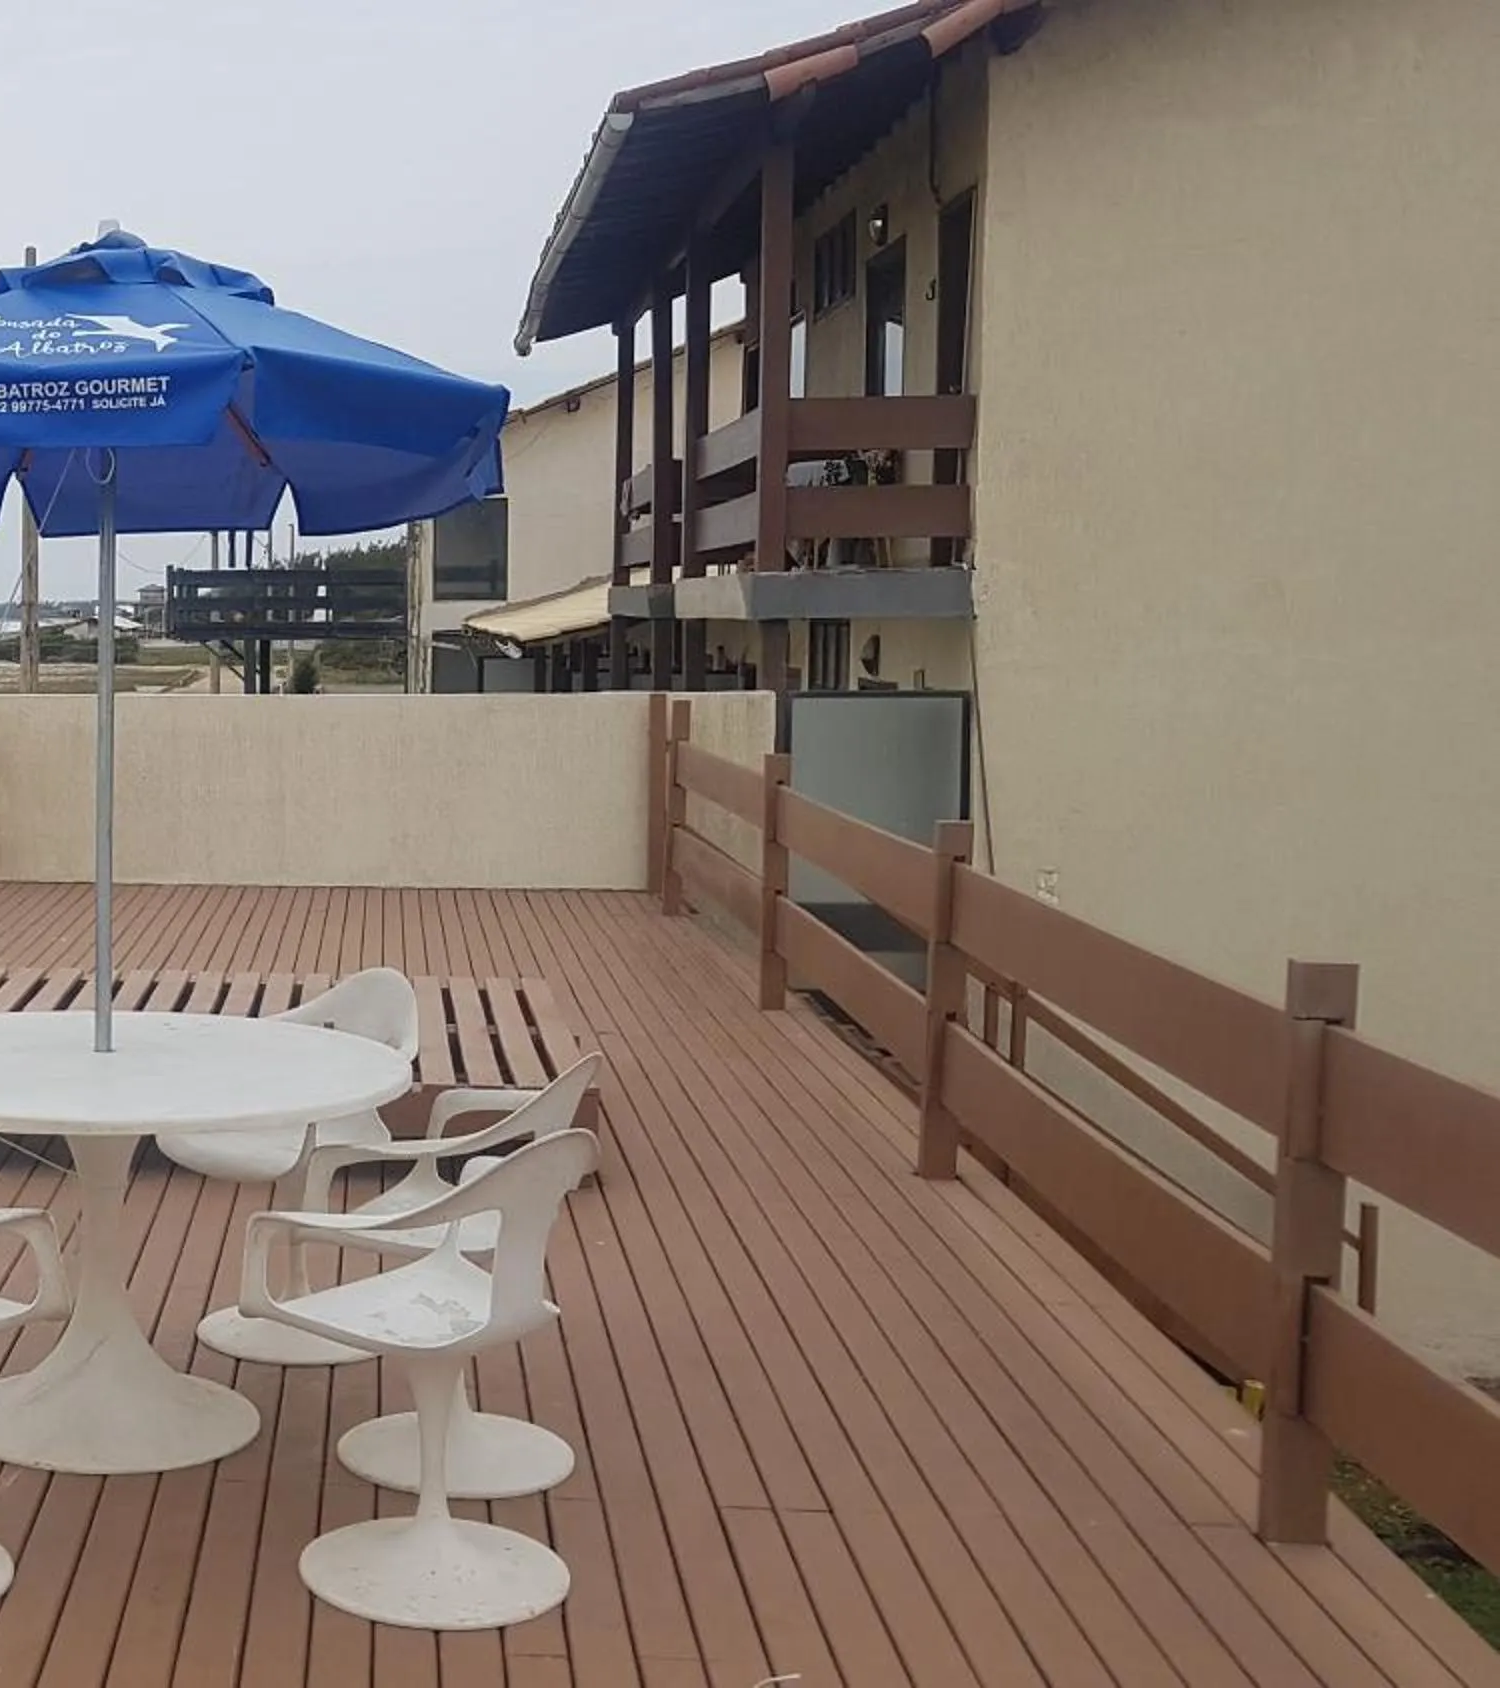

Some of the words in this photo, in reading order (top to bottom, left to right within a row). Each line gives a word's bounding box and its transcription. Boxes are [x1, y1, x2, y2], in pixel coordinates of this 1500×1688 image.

[31, 329, 62, 340] do
[75, 376, 170, 396] GOURMET
[11, 398, 85, 413] 99775-4771
[91, 397, 147, 410] SOLICITE
